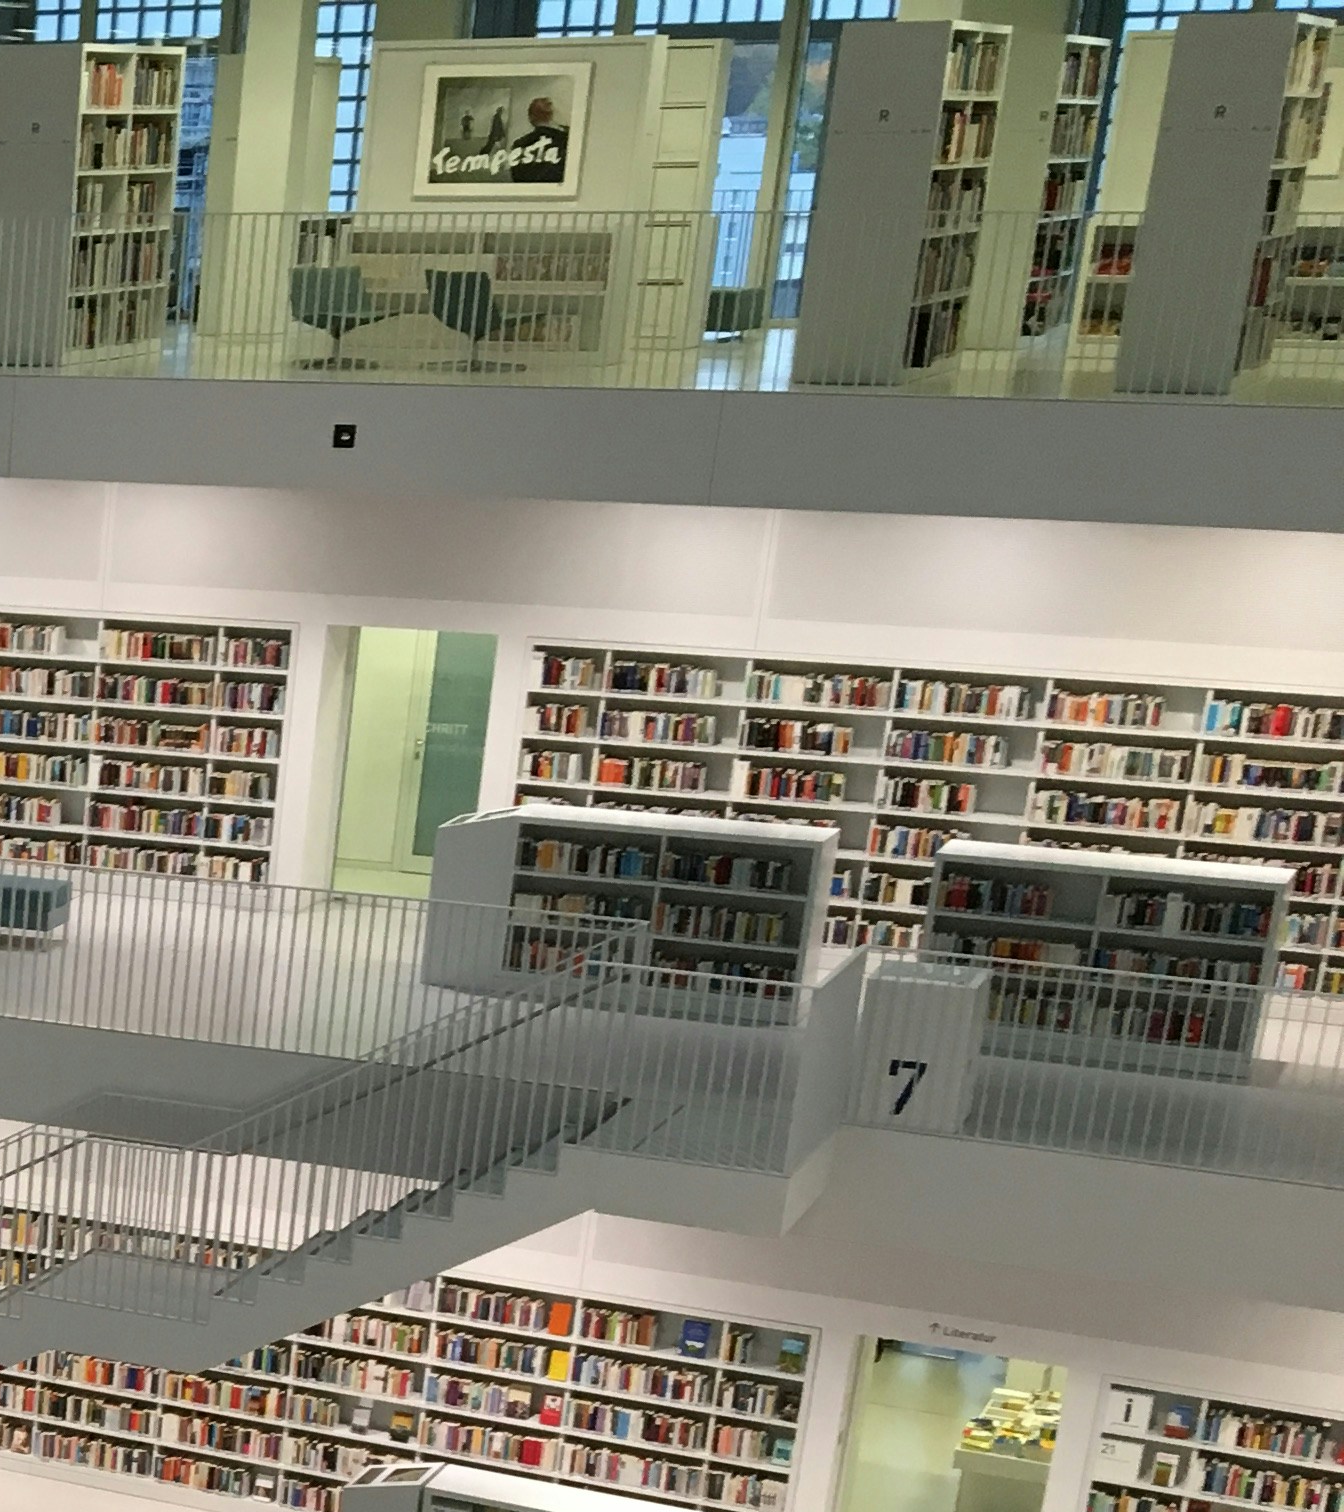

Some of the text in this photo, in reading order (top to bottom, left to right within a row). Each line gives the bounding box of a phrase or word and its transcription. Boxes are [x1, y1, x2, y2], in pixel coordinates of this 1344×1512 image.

[879, 109, 890, 122] R
[1214, 105, 1227, 119] R
[433, 136, 562, 175] Tempesta
[889, 1059, 928, 1116] 7
[943, 1326, 996, 1343] Literatur
